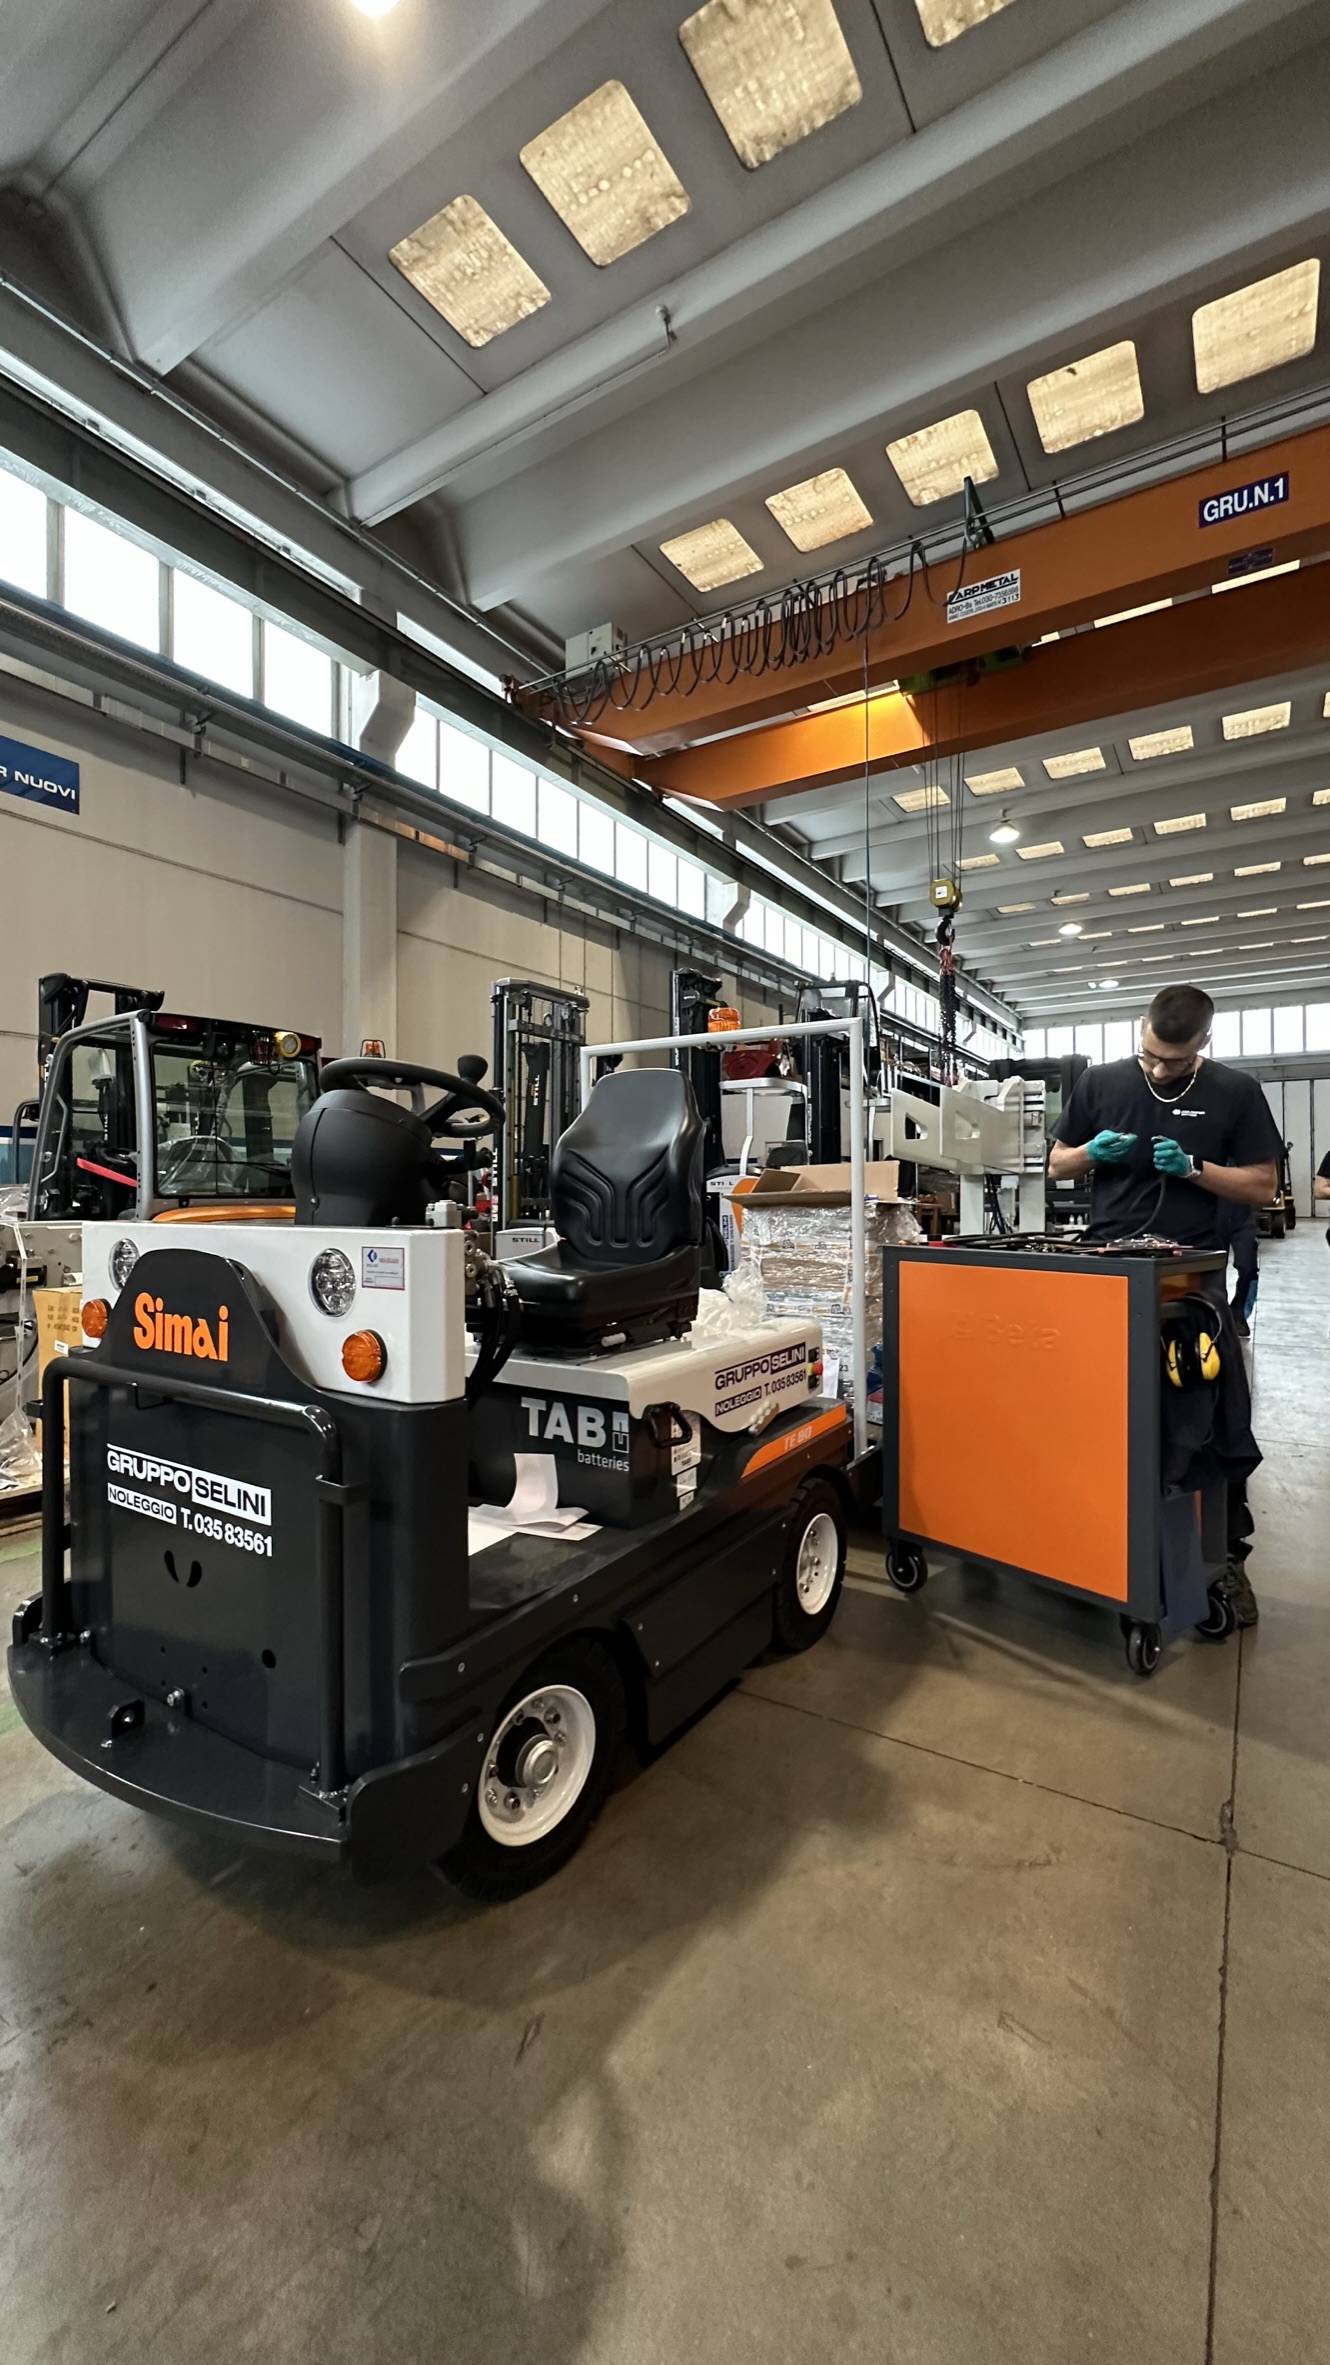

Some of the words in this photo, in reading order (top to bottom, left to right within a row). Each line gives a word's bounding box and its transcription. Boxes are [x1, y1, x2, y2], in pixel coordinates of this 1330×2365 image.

[14, 770, 76, 800] NUOVI
[133, 1291, 229, 1362] Simai
[715, 1358, 770, 1391] GRUPPO
[772, 1346, 805, 1371] SELINI
[716, 1388, 761, 1416] NOLEGGIO
[521, 1396, 607, 1448] TAB
[577, 1448, 630, 1472] batteries
[107, 1450, 191, 1493] GRUPPO
[195, 1476, 266, 1517] SELINI
[109, 1486, 174, 1520] NOLEGGIO
